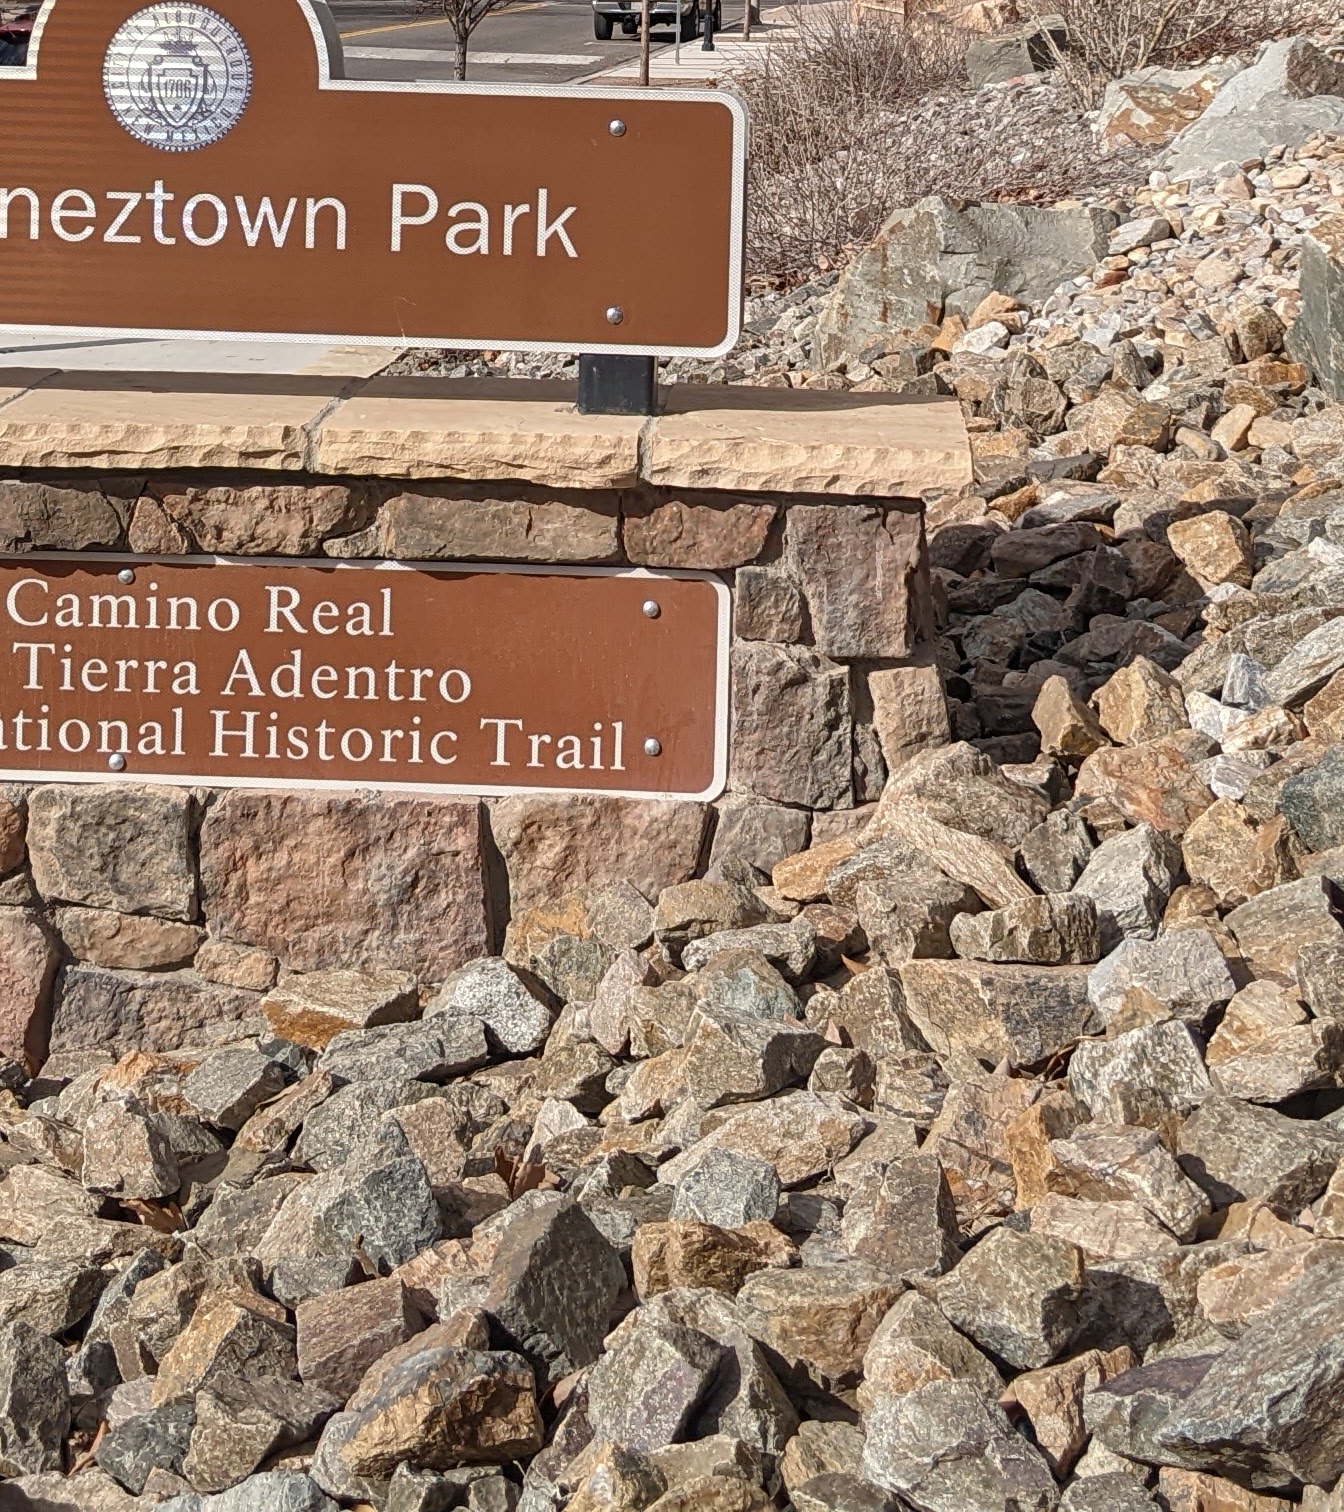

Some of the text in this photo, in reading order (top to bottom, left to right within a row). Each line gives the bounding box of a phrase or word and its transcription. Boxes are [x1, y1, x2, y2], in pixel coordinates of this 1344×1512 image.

[164, 79, 192, 99] 1706
[390, 182, 579, 259] Park
[6, 577, 241, 633] Camino
[263, 585, 396, 637] Real
[12, 642, 201, 696] Tierra
[219, 648, 473, 704] Adentro
[208, 709, 458, 765] Historic
[479, 717, 627, 772] Trail
